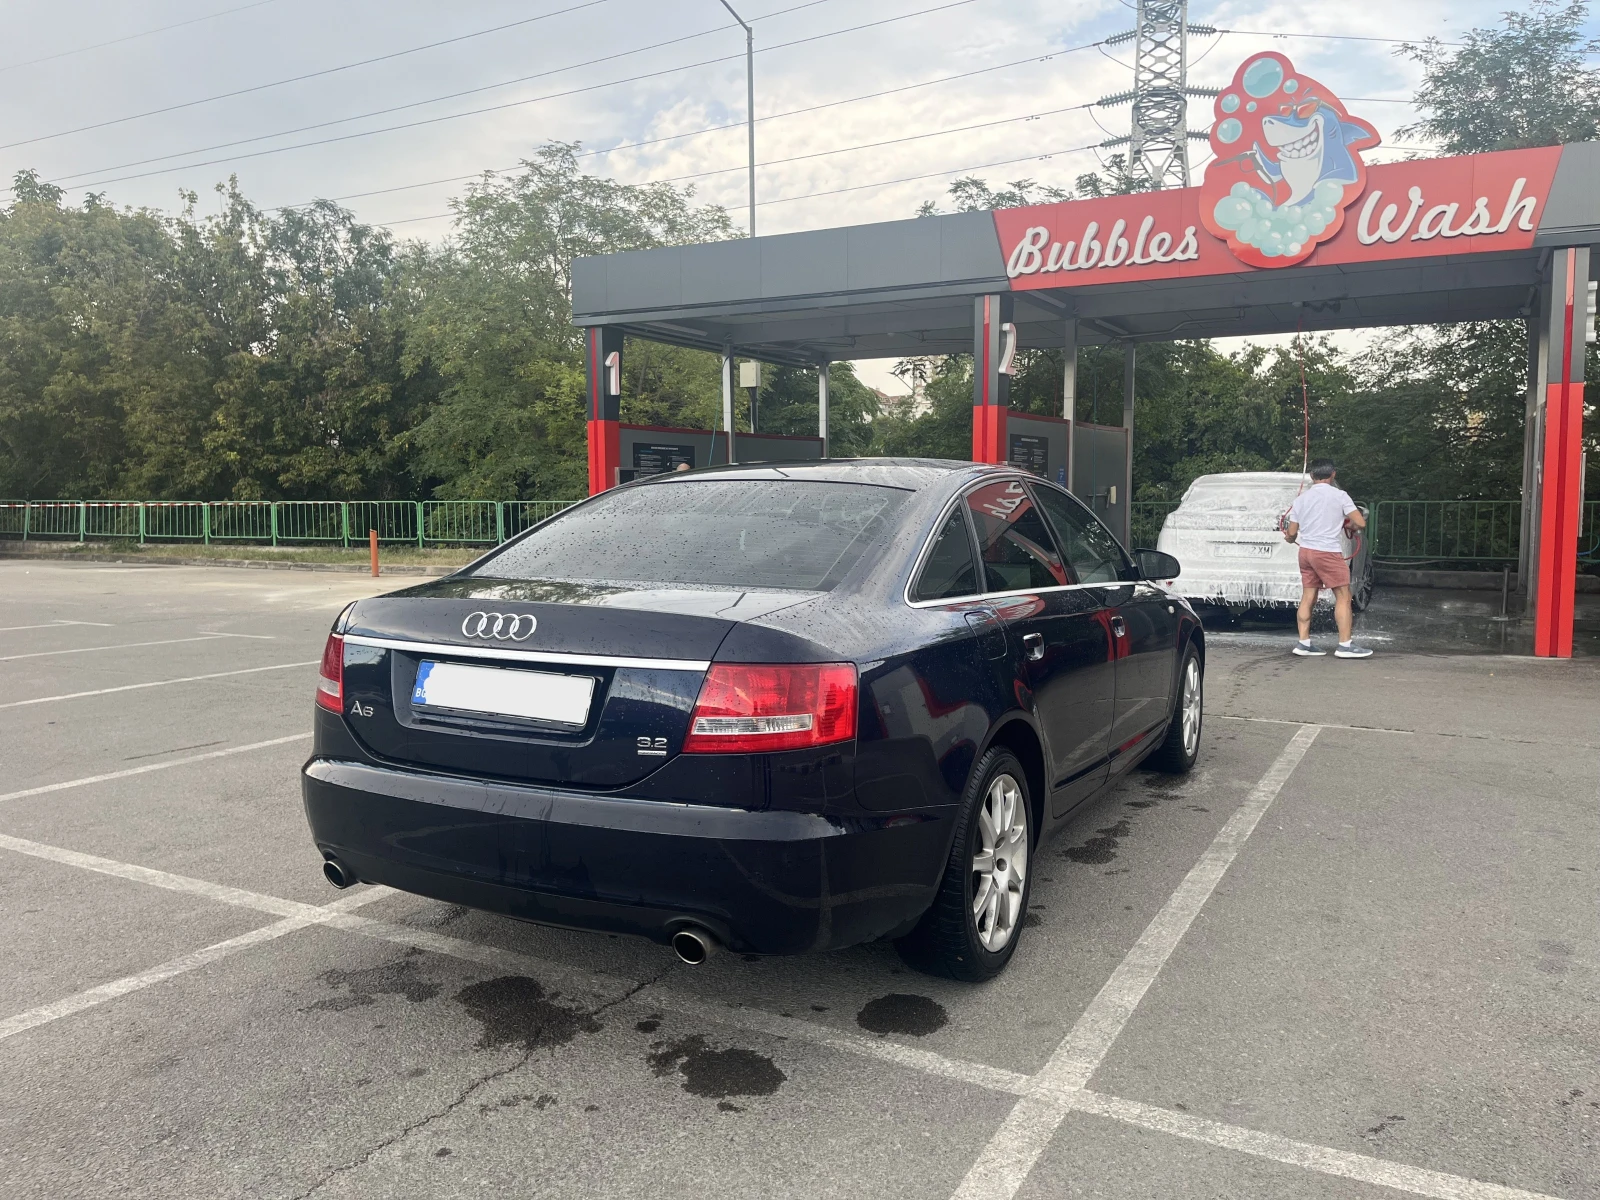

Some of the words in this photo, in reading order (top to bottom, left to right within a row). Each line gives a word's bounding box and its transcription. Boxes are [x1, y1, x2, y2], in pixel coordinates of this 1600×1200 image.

[1007, 215, 1199, 278] Bubbles
[1357, 177, 1537, 245] Wash
[998, 322, 1018, 376] 2
[604, 350, 620, 396] 1
[350, 700, 374, 717] A6
[636, 736, 667, 748] 3.2
